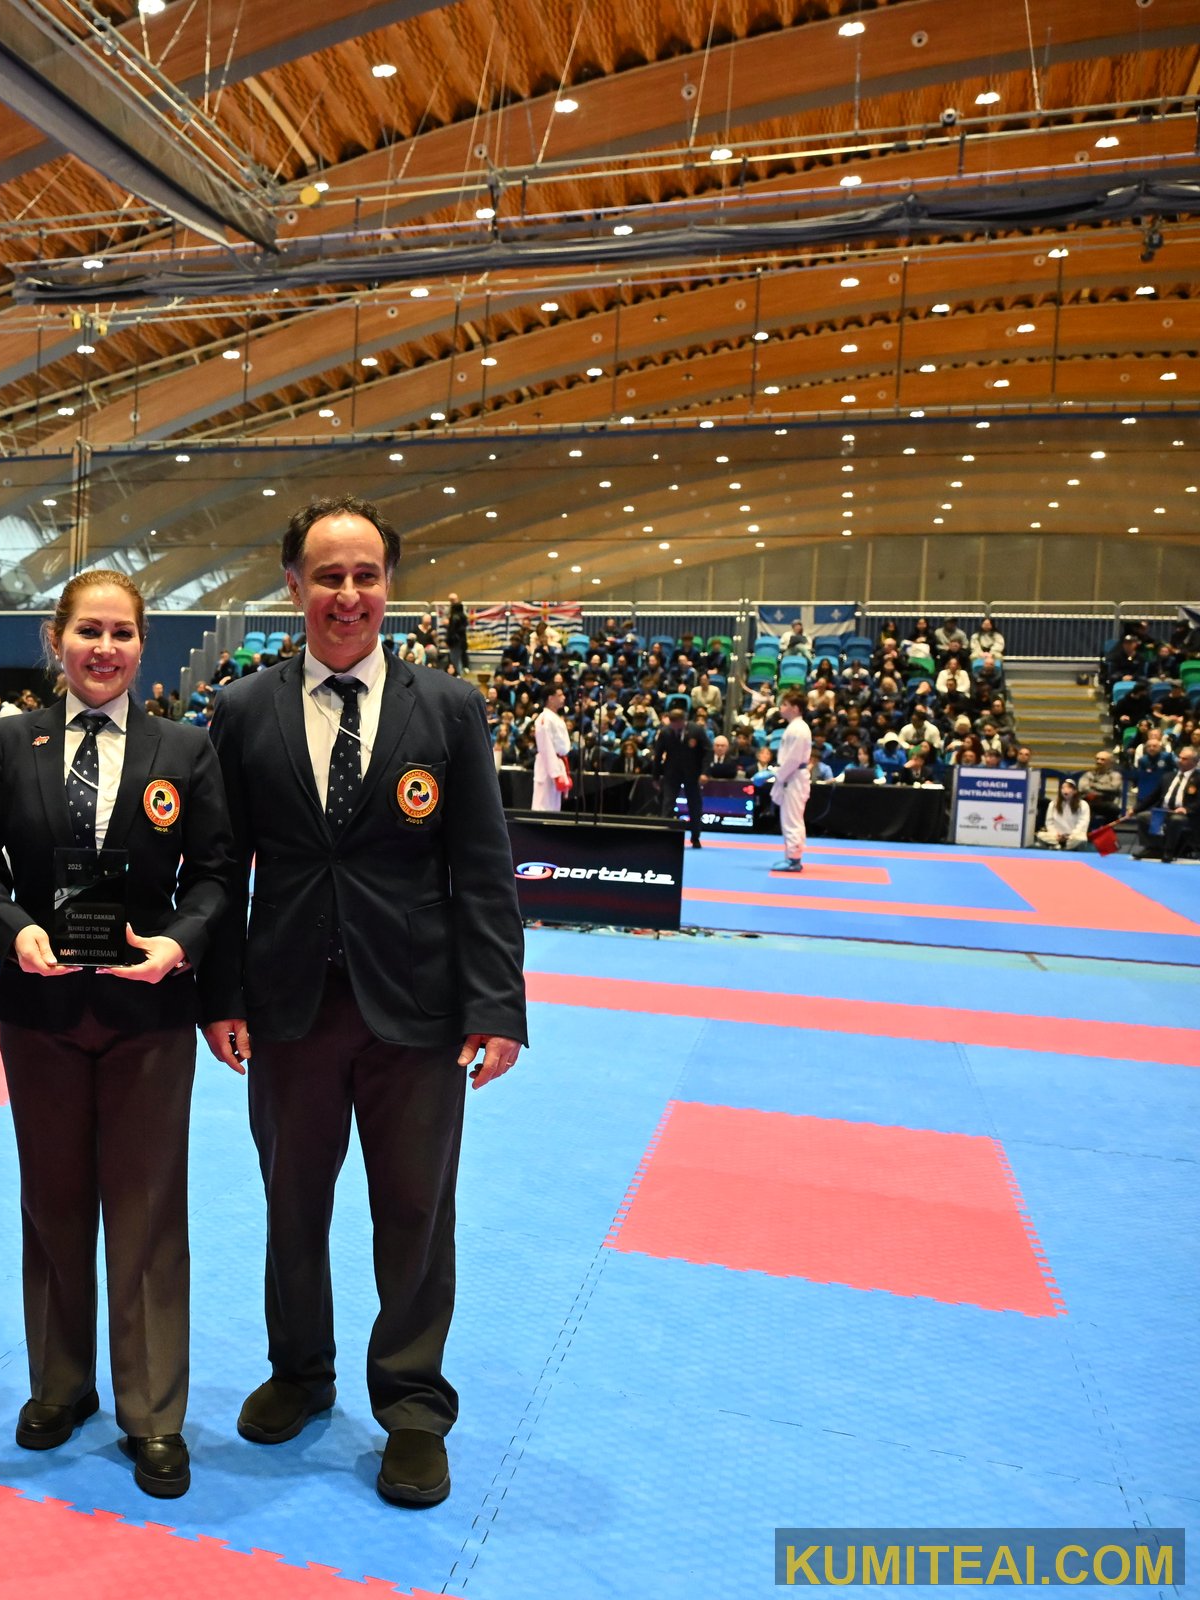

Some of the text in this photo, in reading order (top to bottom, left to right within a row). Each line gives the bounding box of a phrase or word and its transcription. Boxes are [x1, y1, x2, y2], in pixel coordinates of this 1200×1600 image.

[403, 771, 435, 787] PANAMERICAN
[154, 781, 172, 790] WORLD
[975, 780, 1008, 789] COACH
[410, 798, 436, 817] FEDERATION
[406, 817, 423, 825] JUDGE
[59, 948, 118, 957] MARYAM KERMANI
